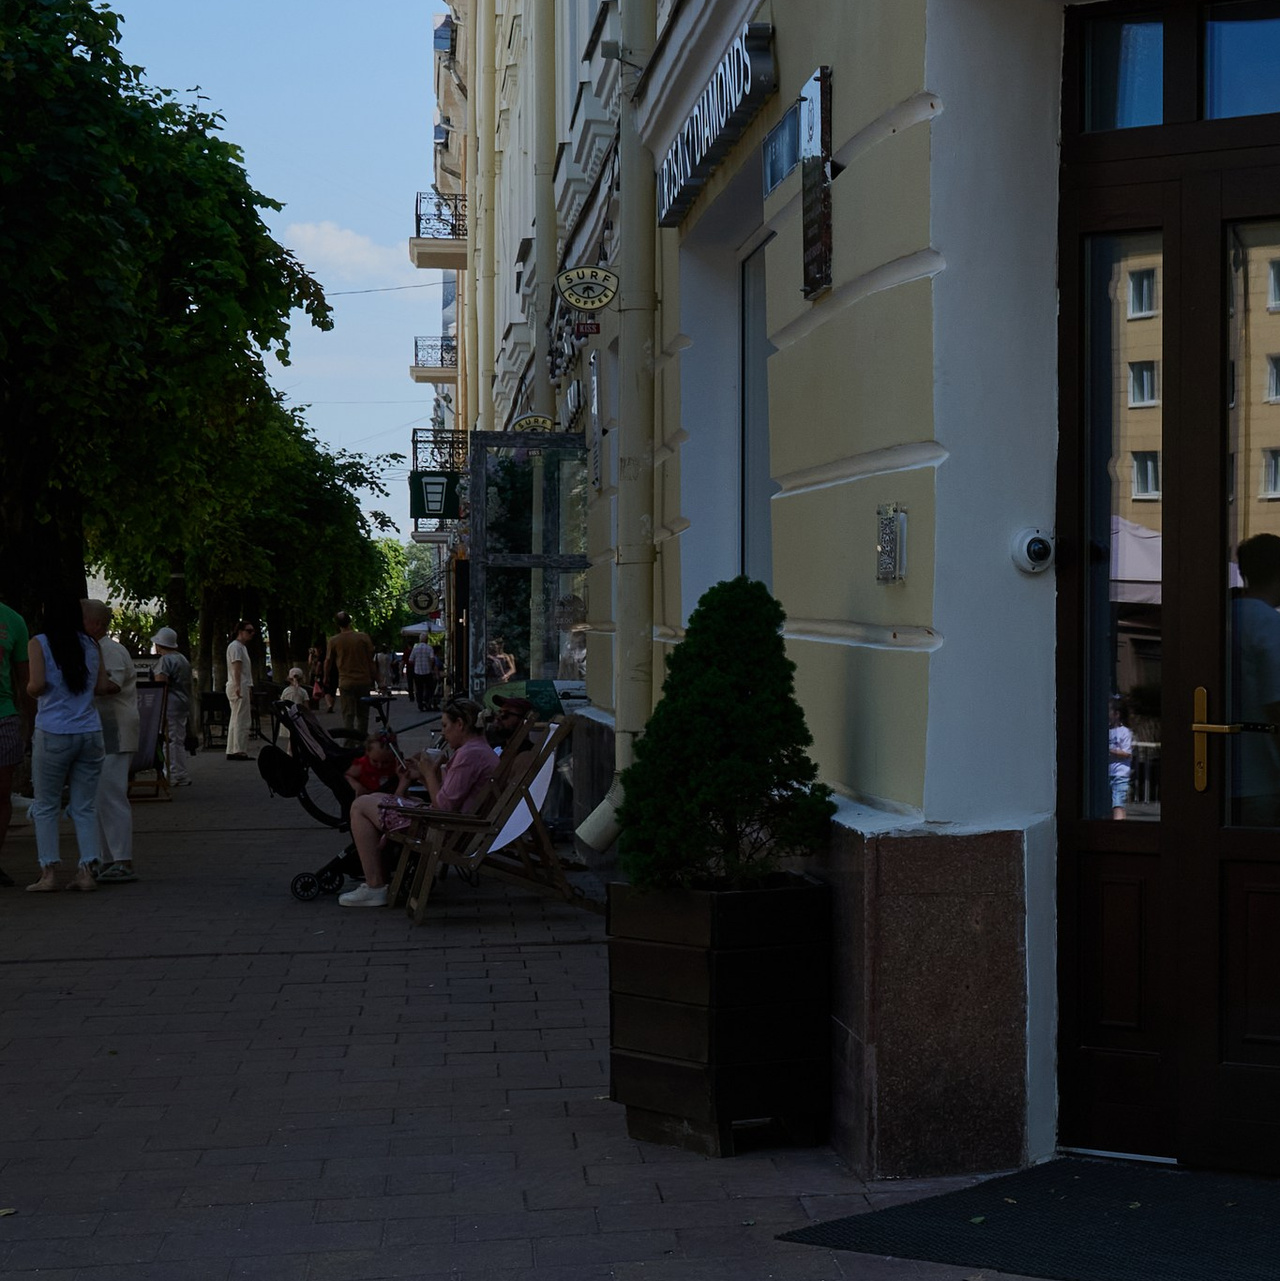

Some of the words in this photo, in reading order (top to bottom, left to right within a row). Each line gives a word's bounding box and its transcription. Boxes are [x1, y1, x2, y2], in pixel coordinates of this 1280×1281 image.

[693, 22, 751, 166] DIAMONDS
[564, 270, 612, 285] SURF
[568, 292, 610, 307] COFFEE
[578, 324, 598, 333] KISS
[518, 418, 548, 429] SURF
